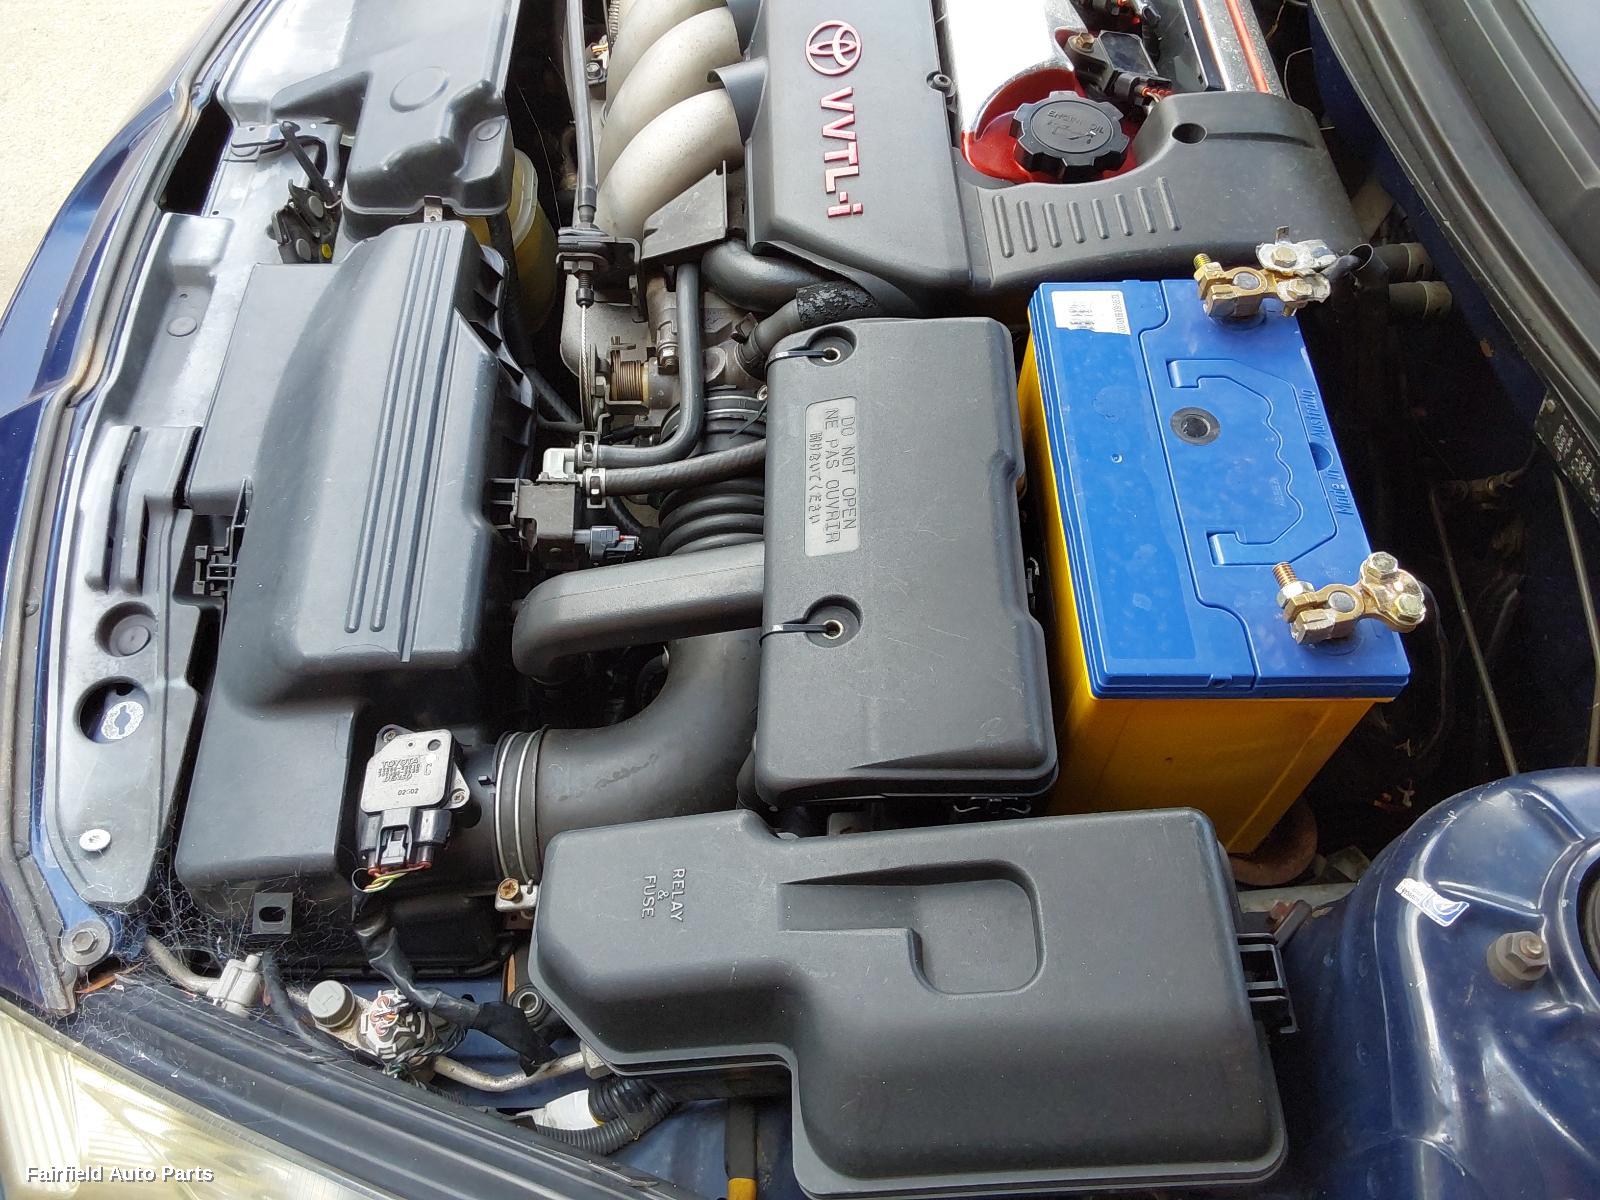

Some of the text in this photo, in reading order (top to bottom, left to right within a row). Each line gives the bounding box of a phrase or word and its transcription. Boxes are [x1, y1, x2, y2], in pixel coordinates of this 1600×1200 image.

[820, 86, 863, 219] VVTL-i
[825, 408, 841, 544] NE PAS OUVRIR
[841, 416, 857, 530] DO NOT OPEN
[641, 874, 657, 919] FUSE
[657, 888, 670, 901] &
[670, 868, 687, 922] RELAY
